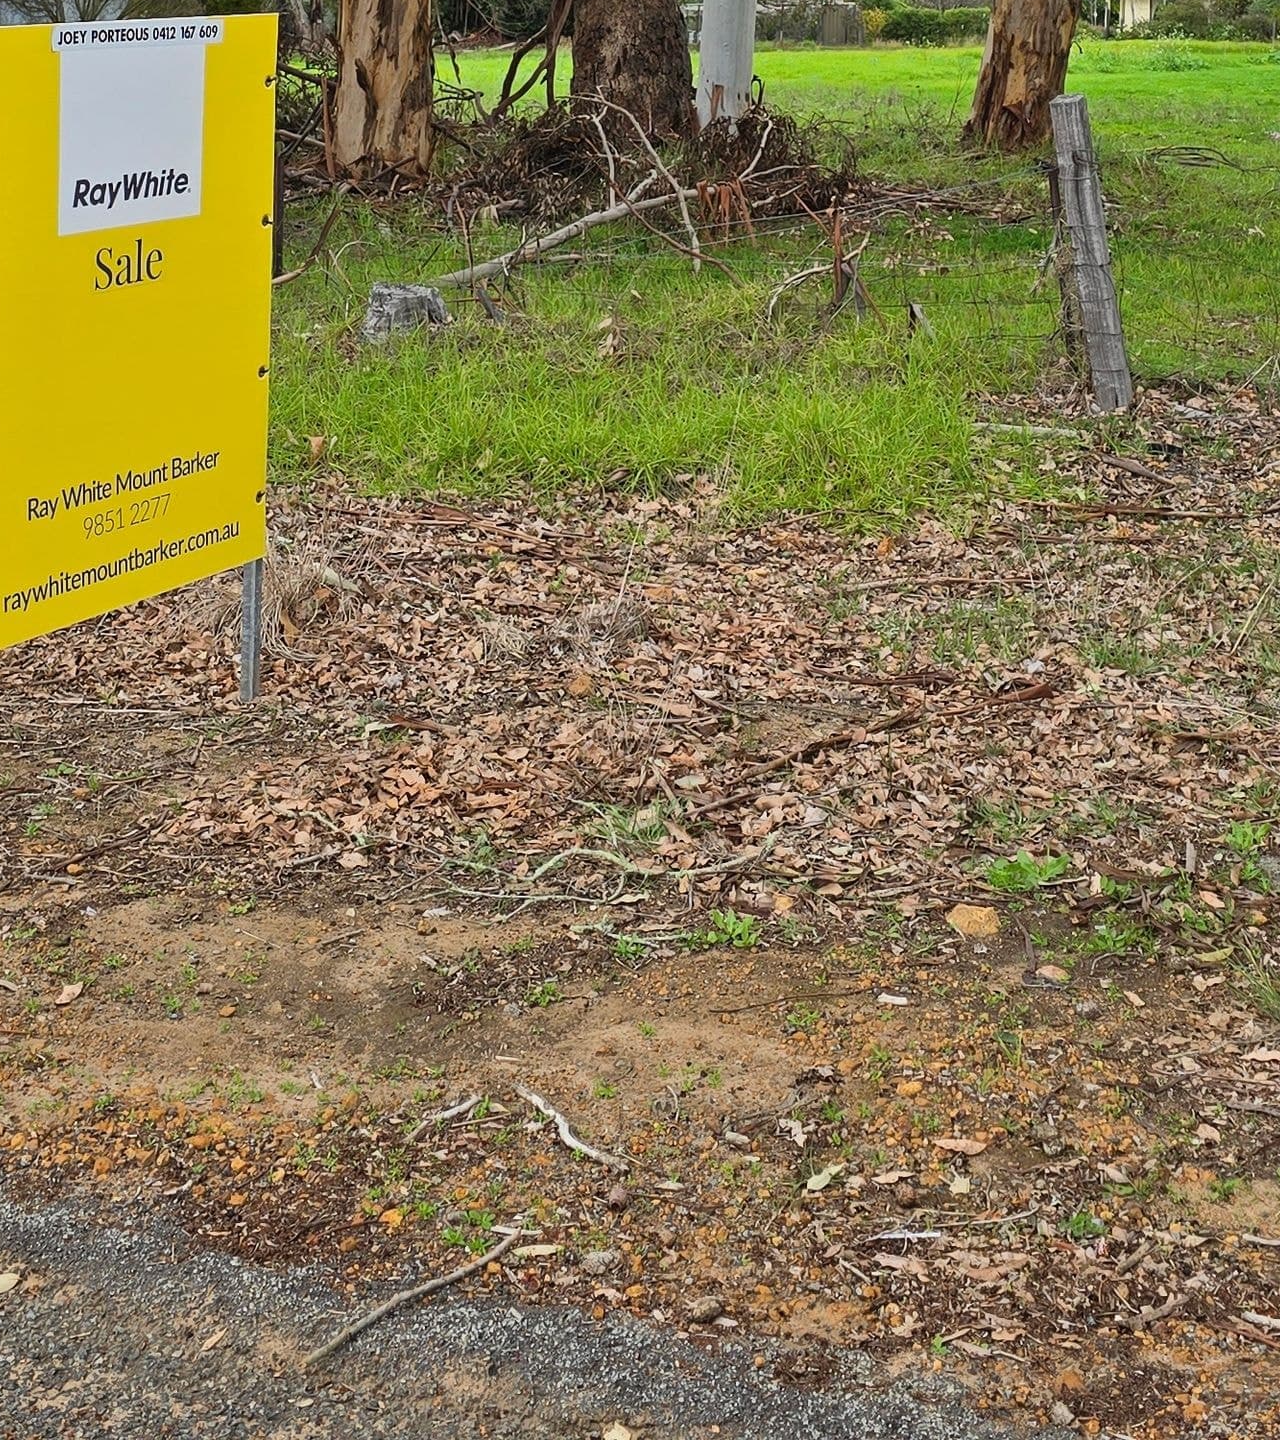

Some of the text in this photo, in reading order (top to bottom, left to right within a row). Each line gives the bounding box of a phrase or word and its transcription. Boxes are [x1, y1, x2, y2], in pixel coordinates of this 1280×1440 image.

[57, 25, 218, 45] JOEY PORTEOUS 0412 167 609
[94, 238, 163, 291] Sale
[27, 449, 220, 521] Ray White Mount Barker
[83, 493, 171, 540] 9851 2277
[3, 521, 240, 613] raywhitemountbarker.com.au
